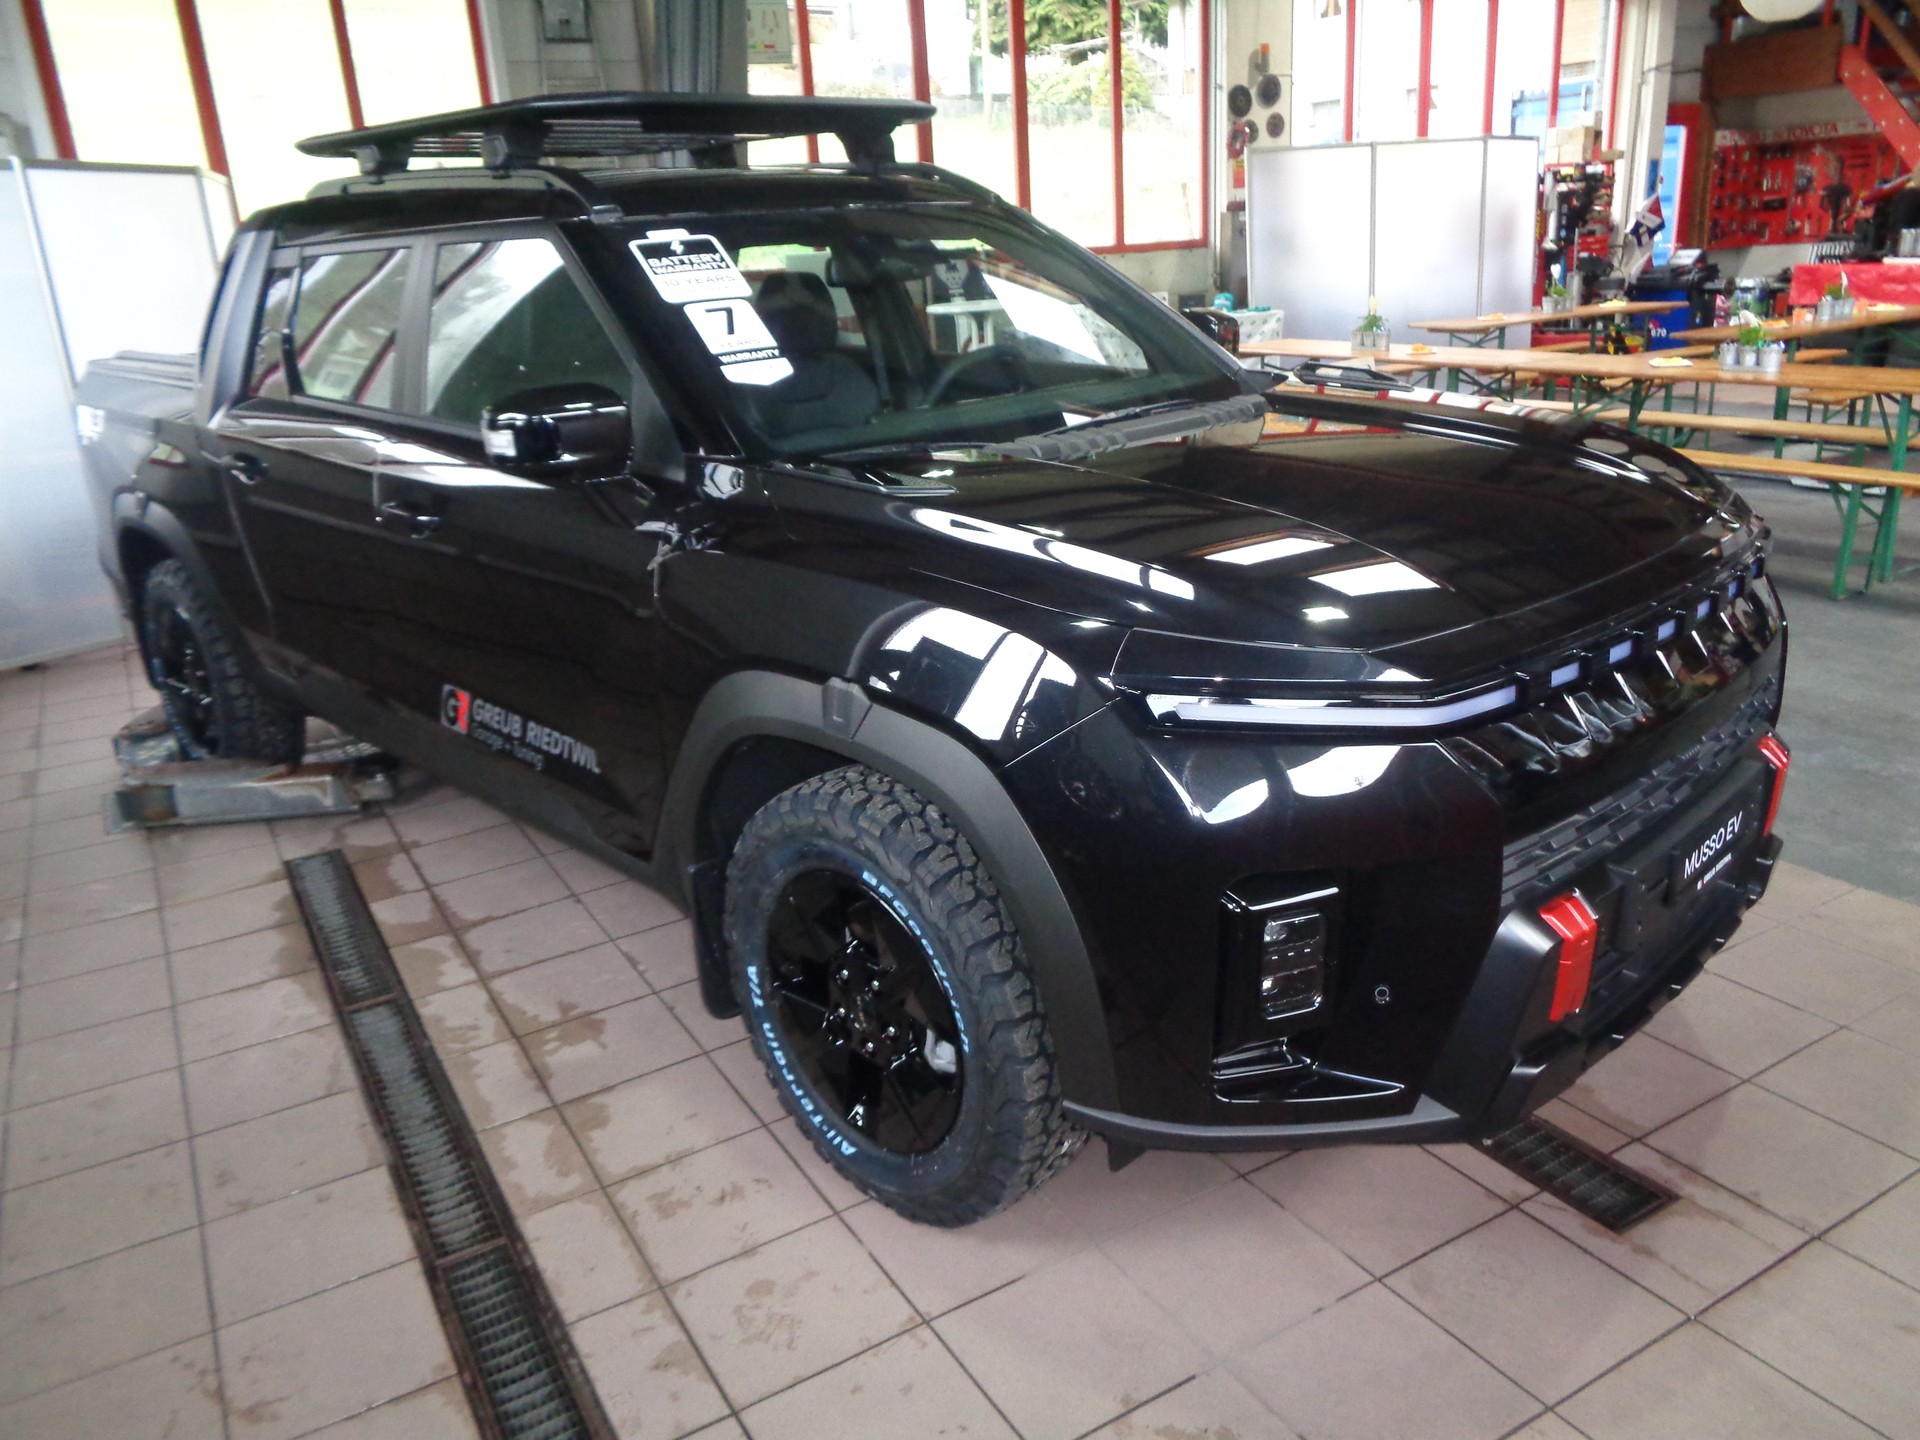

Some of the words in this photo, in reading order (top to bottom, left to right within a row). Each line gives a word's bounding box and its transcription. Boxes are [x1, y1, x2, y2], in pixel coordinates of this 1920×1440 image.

[647, 253, 721, 269] BATTERY
[652, 261, 728, 275] WARRANTY
[664, 279, 680, 287] 10
[684, 274, 736, 285] YEARS
[704, 306, 735, 336] 7
[718, 348, 780, 365] WARRANTY
[472, 698, 523, 738] GREUB
[526, 720, 601, 774] RIEDTWIL
[1684, 827, 1725, 879] MUSSO
[1726, 811, 1743, 841] EV
